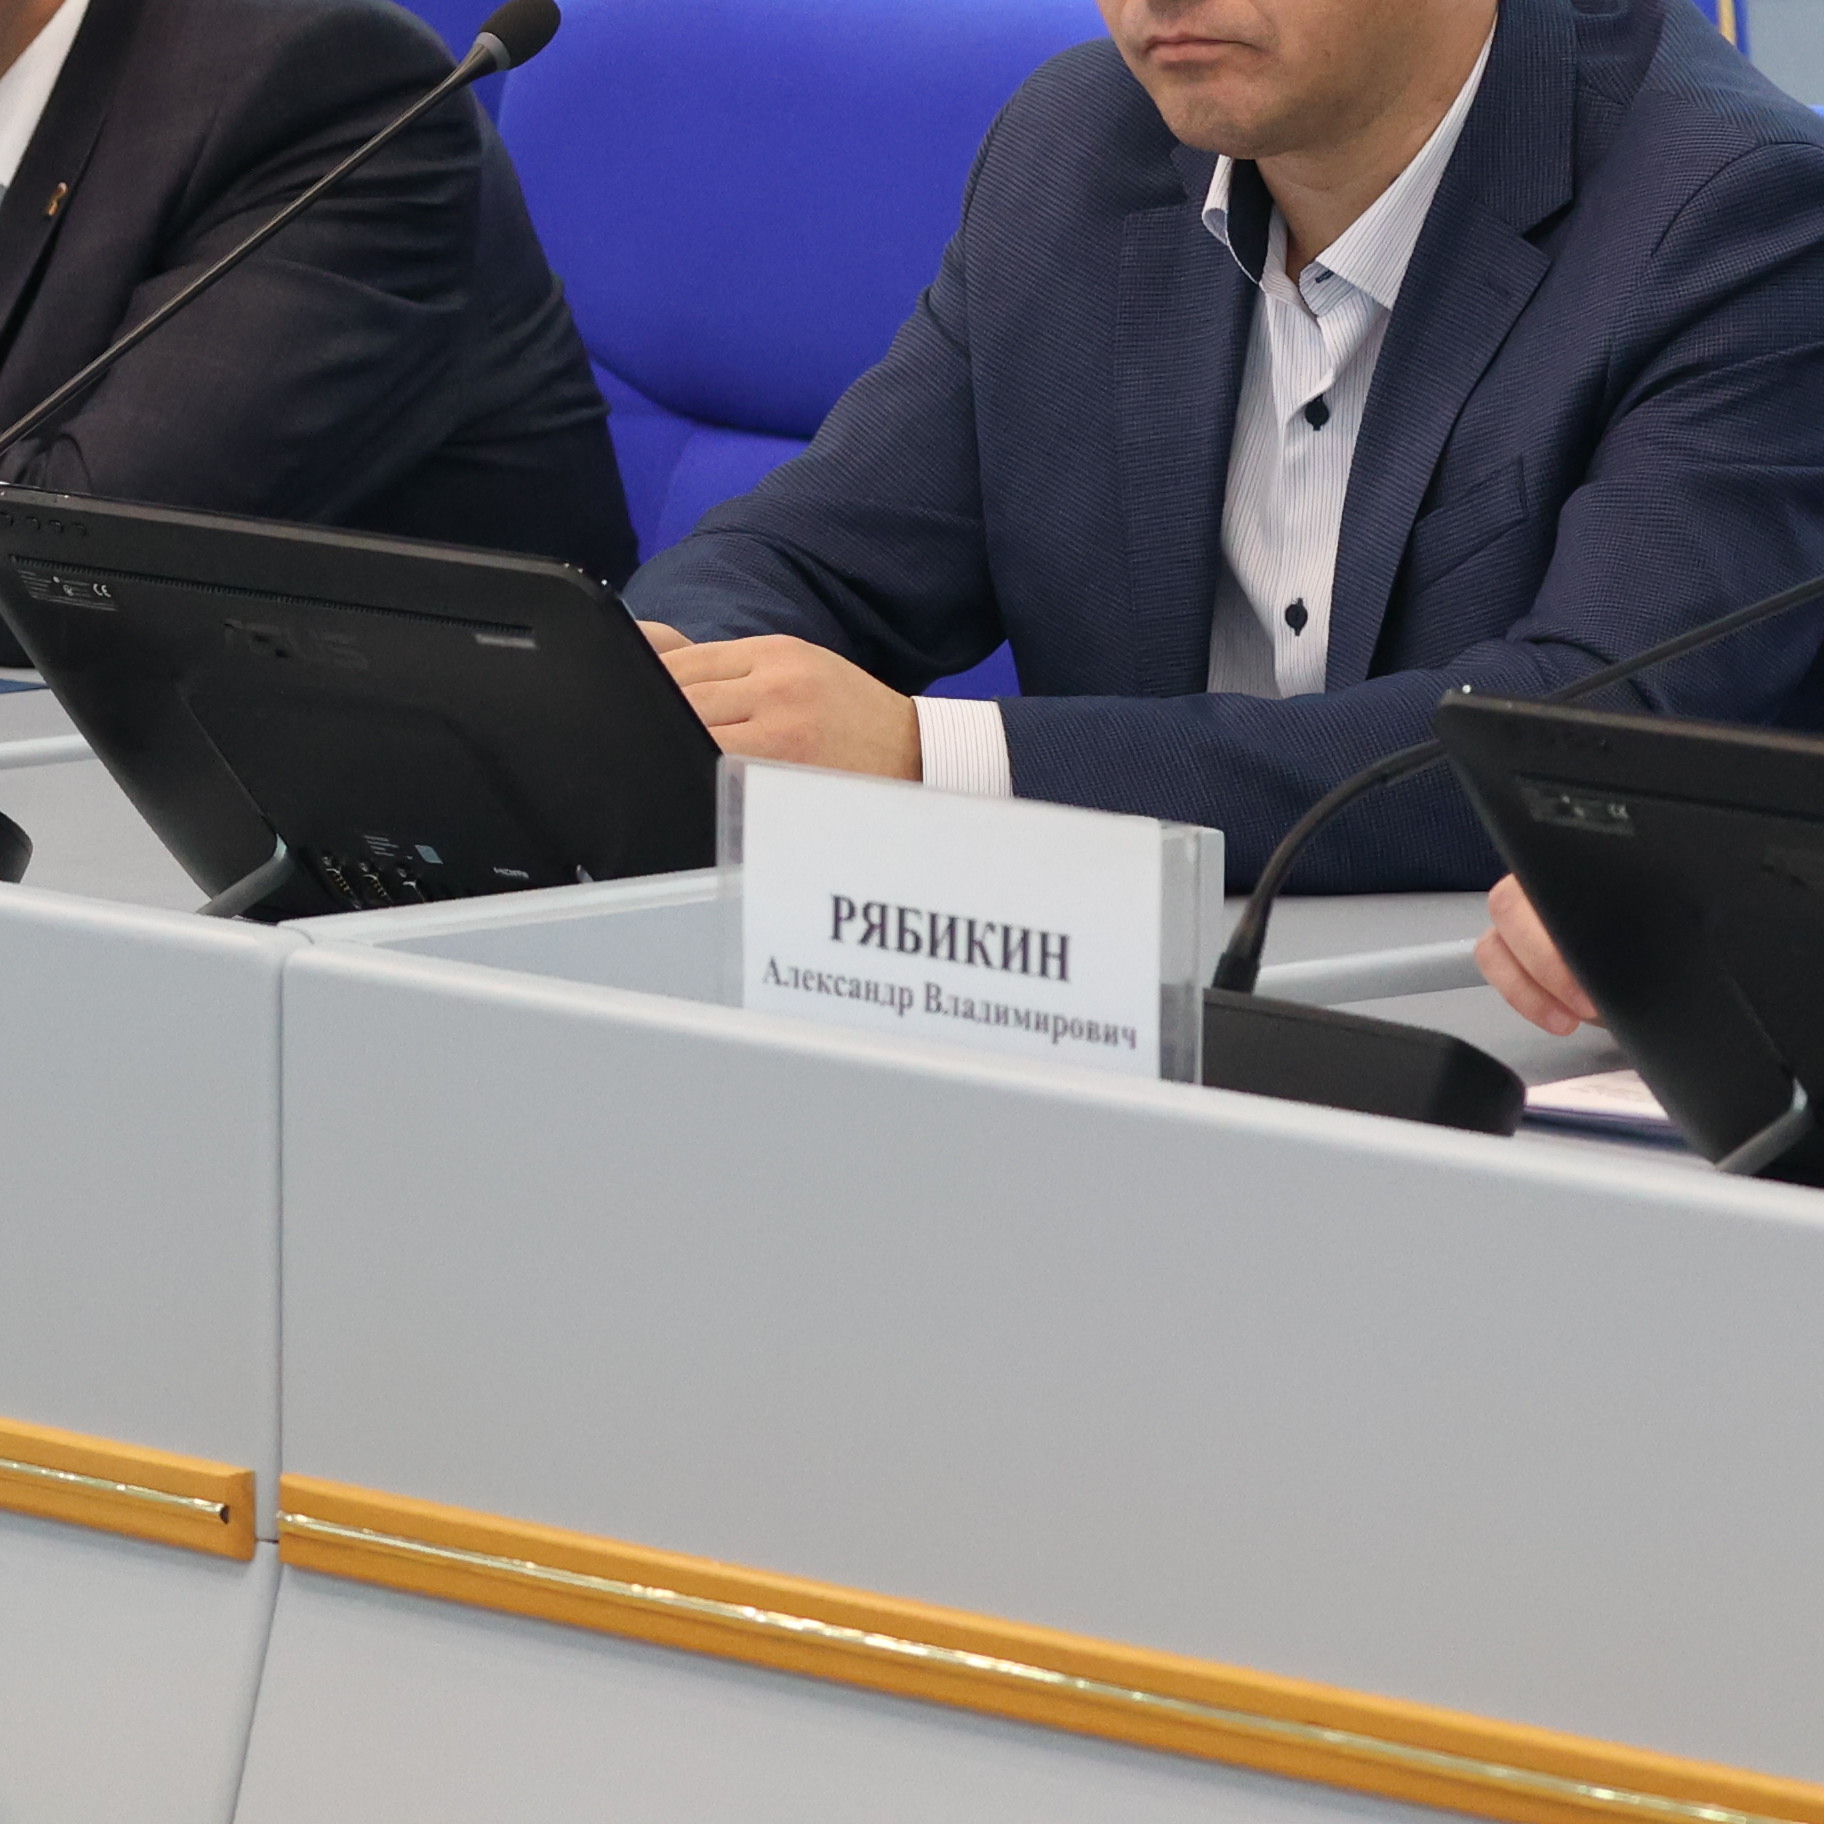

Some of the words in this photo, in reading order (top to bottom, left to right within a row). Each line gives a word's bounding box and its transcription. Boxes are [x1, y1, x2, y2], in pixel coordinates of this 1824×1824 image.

[829, 893, 1072, 983] РЯБИКИН
[762, 957, 915, 1017] Александр
[923, 982, 1138, 1051] Владимирович
